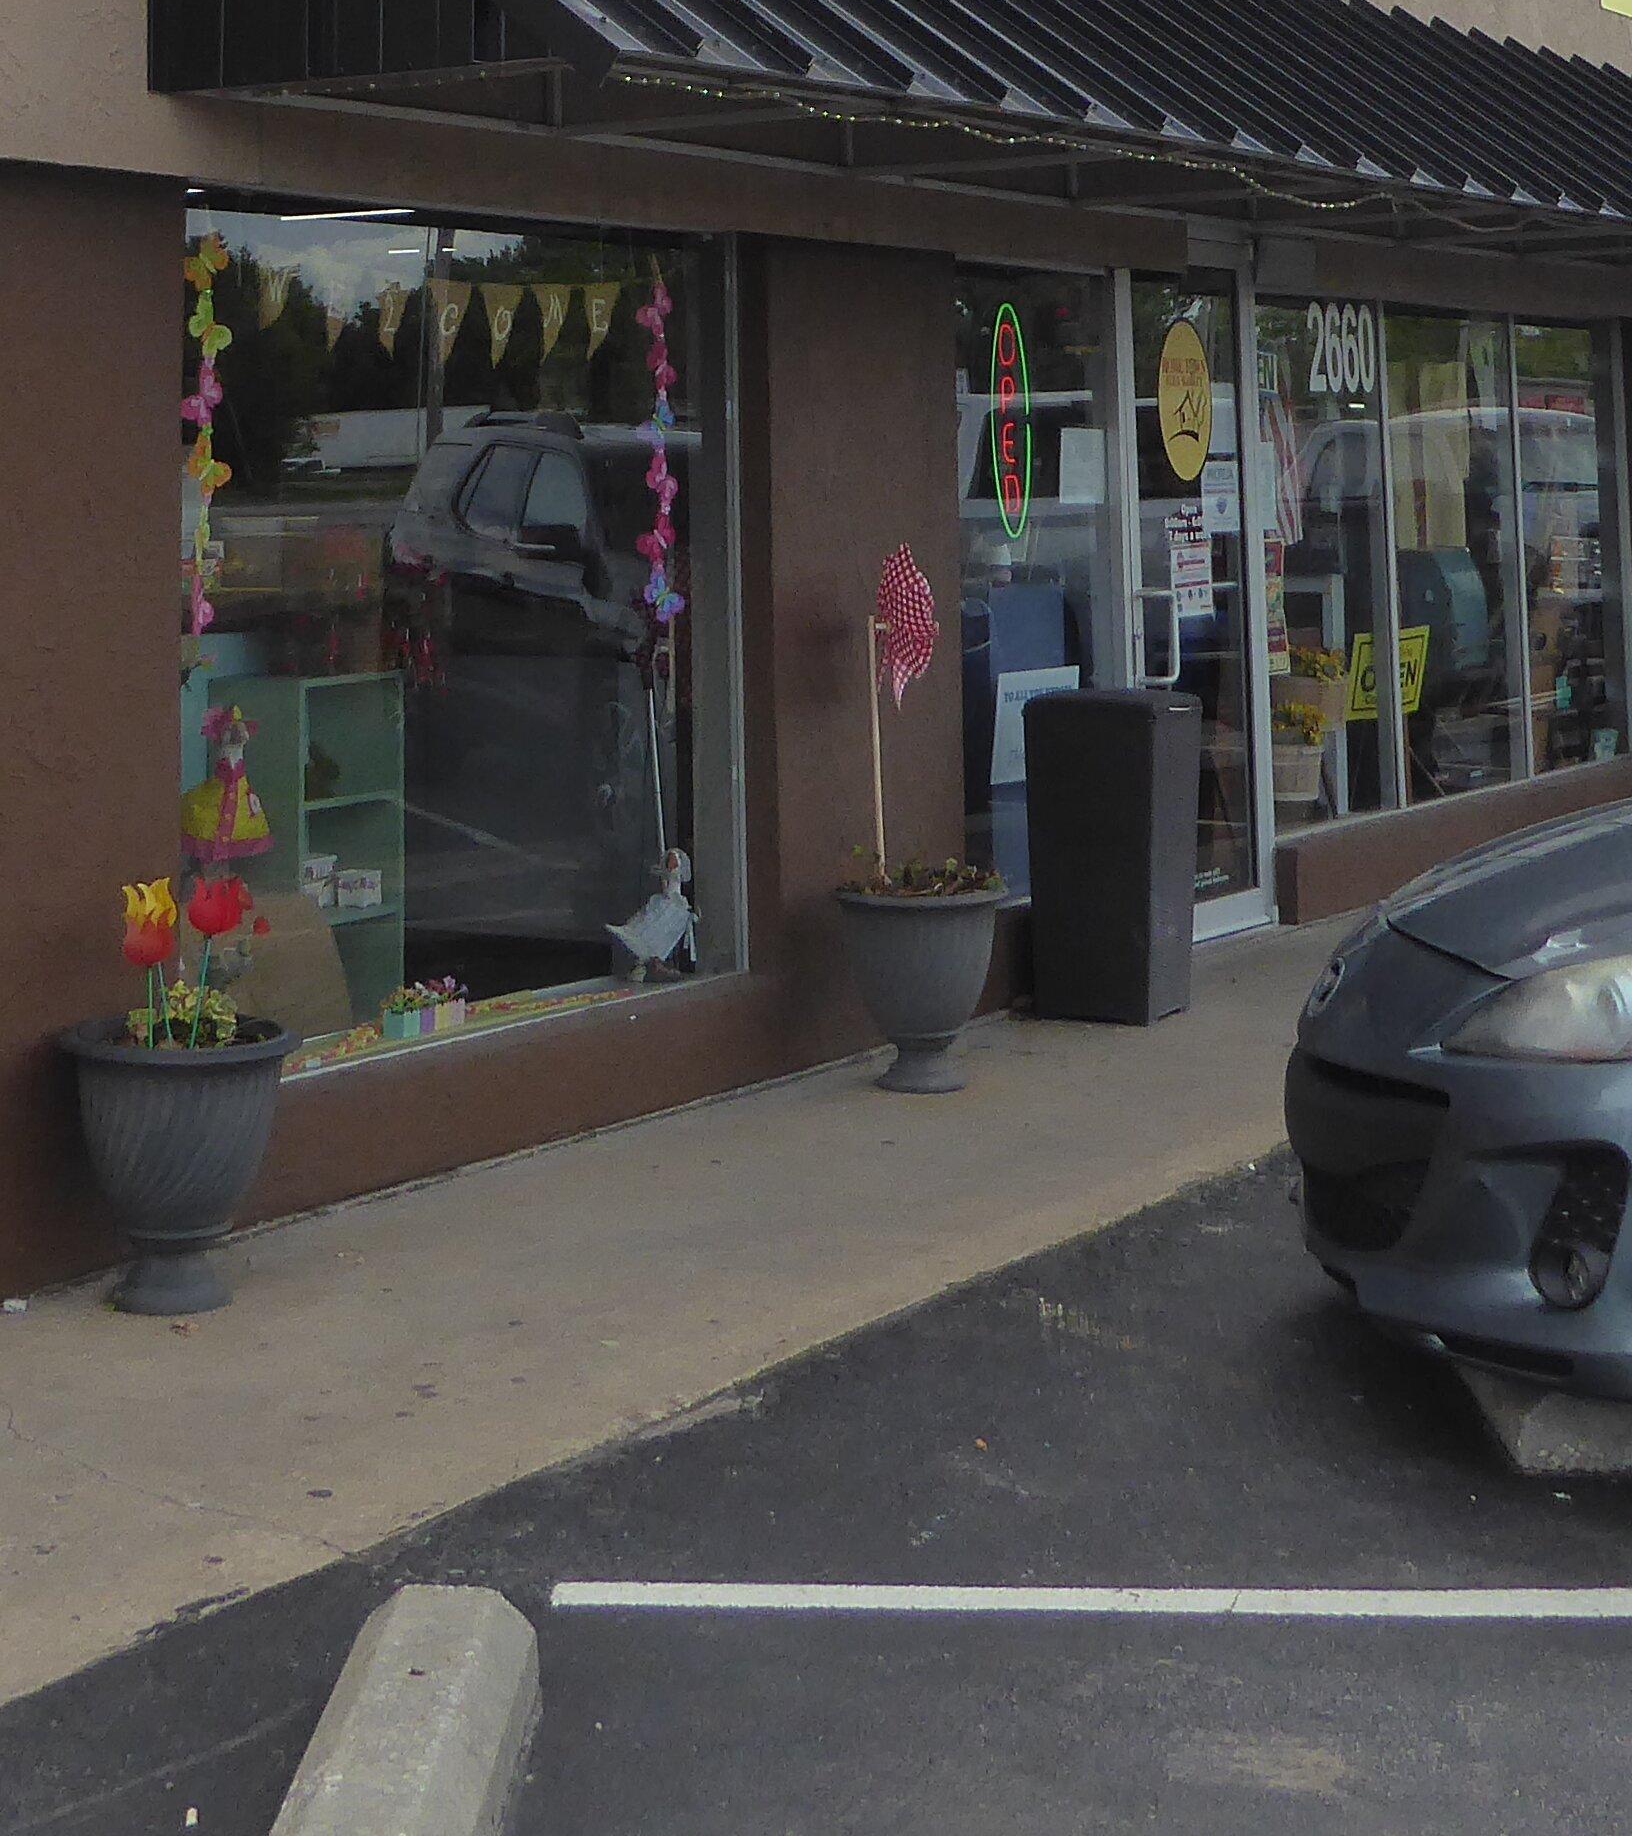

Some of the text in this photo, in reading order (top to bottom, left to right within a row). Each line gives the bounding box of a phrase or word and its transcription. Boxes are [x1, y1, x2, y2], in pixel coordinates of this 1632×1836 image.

[267, 266, 609, 341] WLCOME
[1306, 300, 1375, 394] 2660
[1360, 658, 1418, 693] OEN
